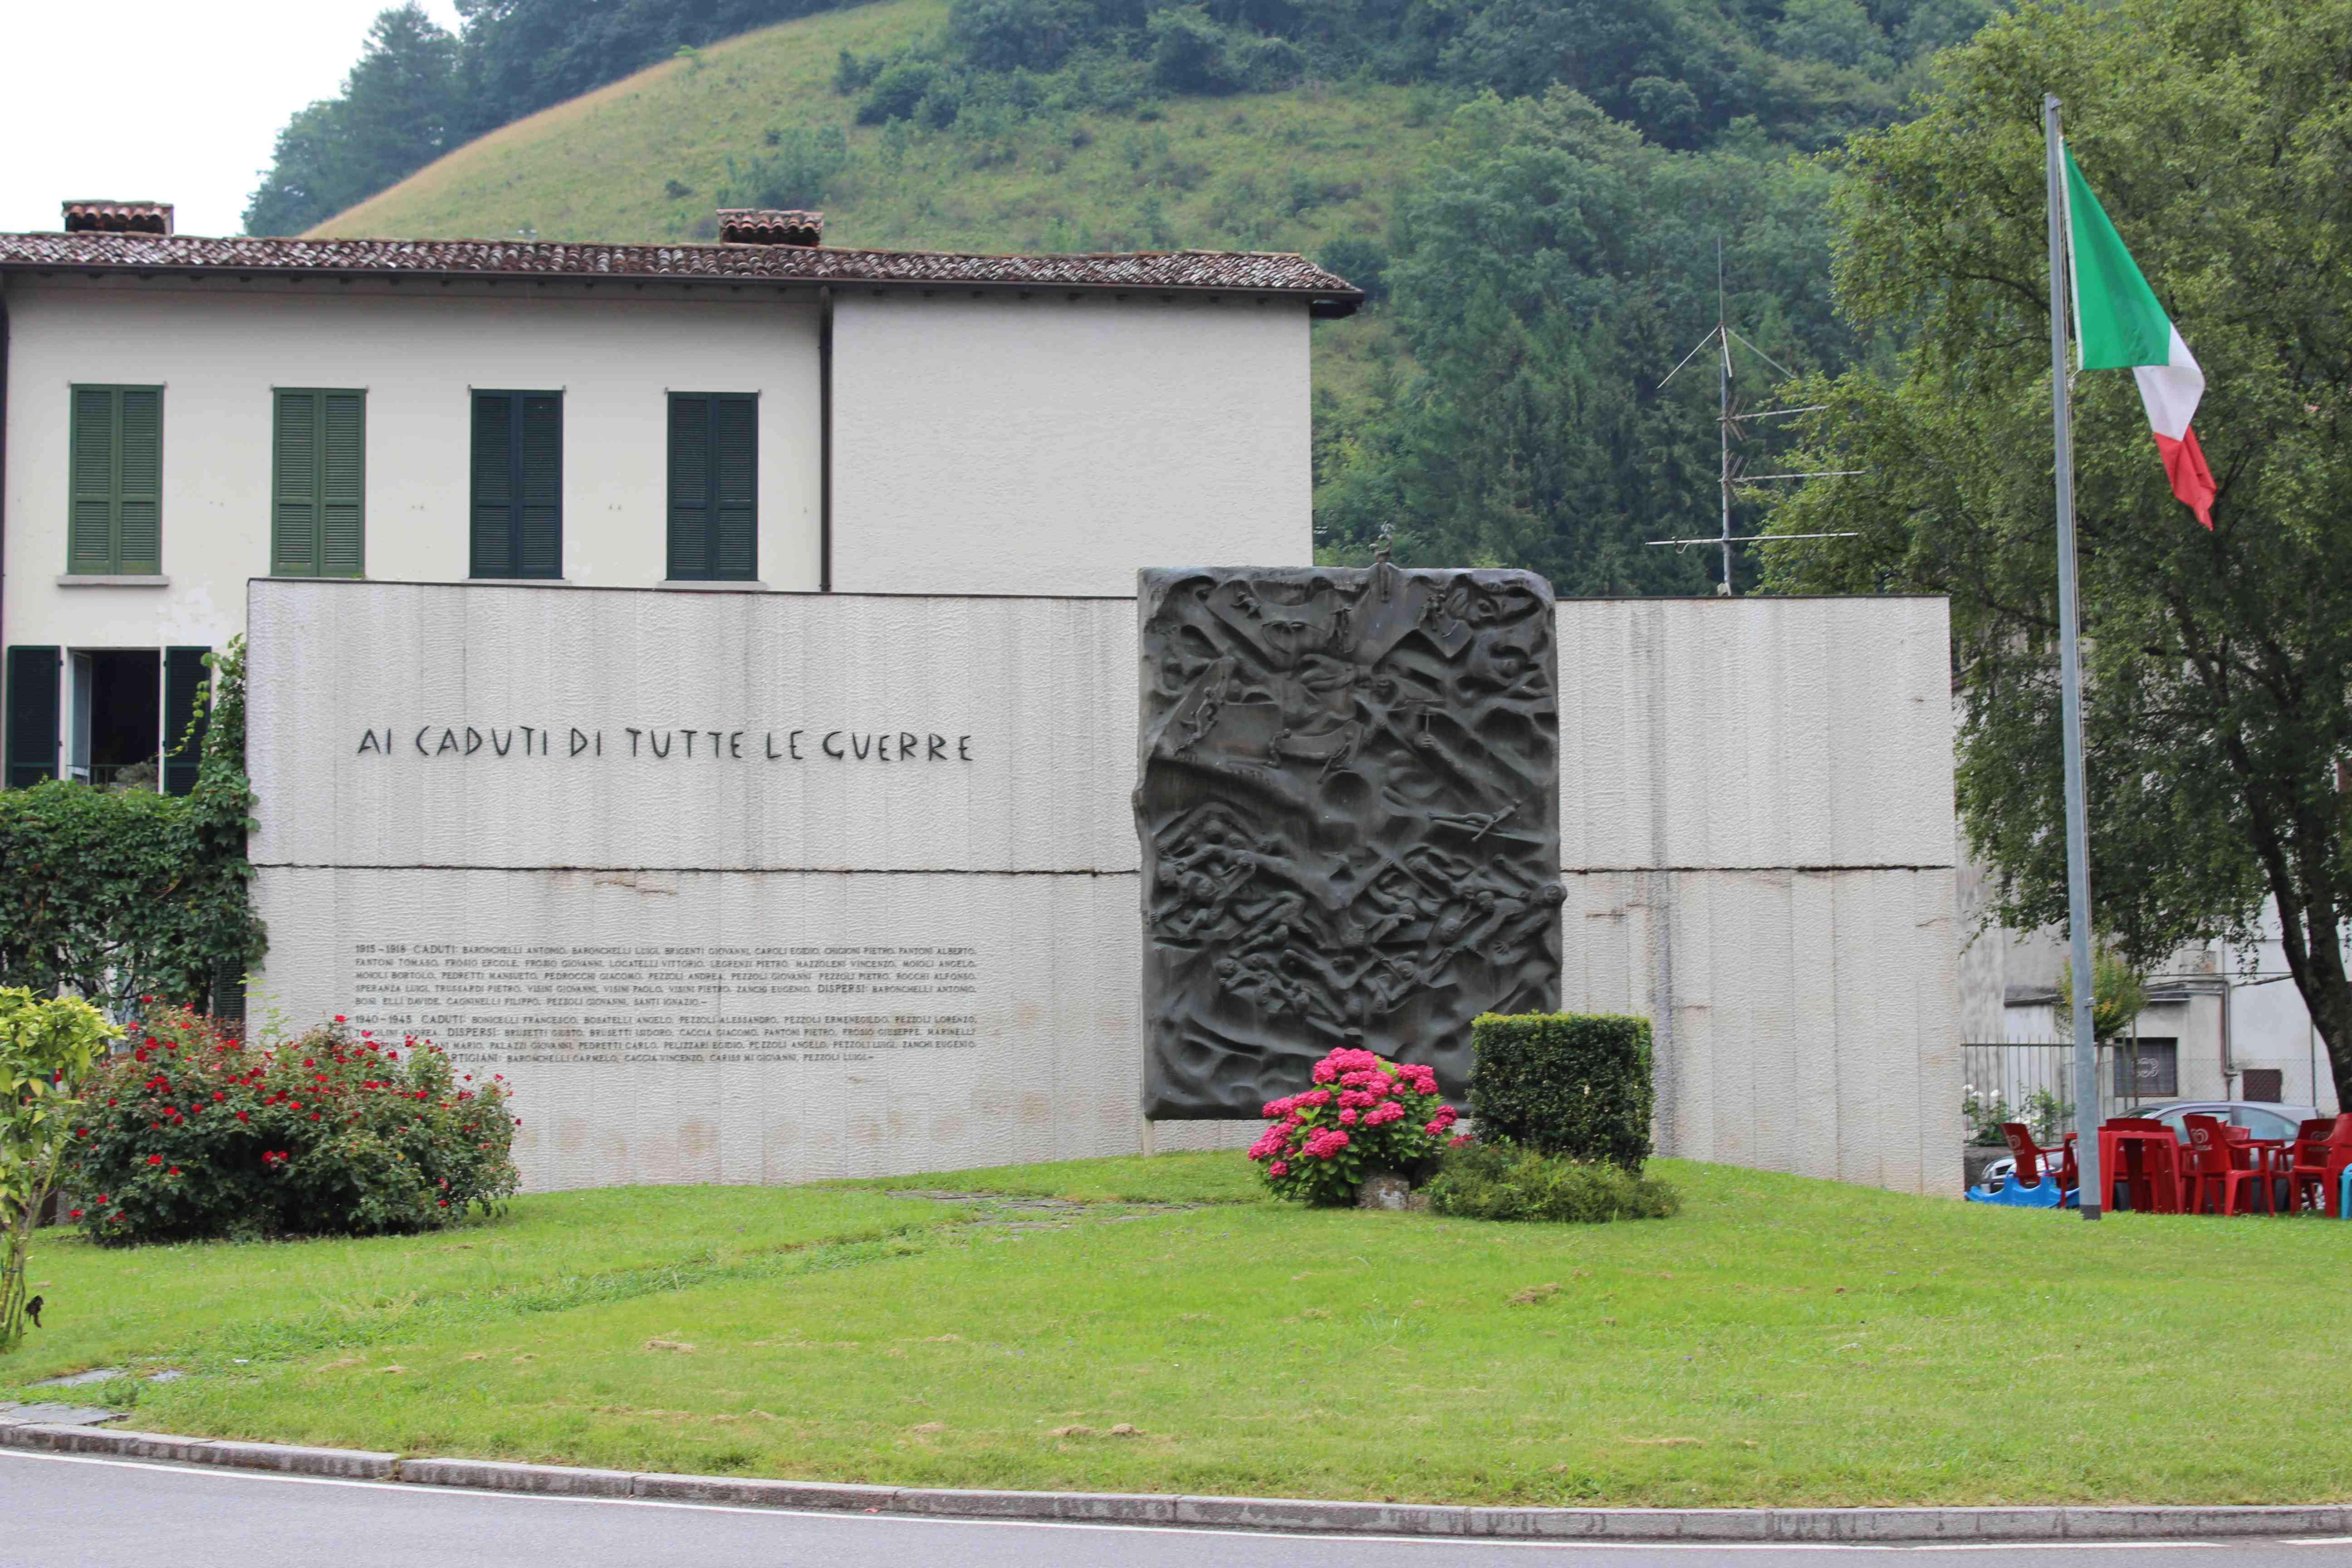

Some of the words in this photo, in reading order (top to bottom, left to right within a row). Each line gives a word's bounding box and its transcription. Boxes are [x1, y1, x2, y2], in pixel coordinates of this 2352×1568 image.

[358, 729, 391, 754] AI
[416, 726, 547, 756] CADUTI
[570, 728, 600, 756] DI
[626, 728, 744, 758] TUTTE
[766, 730, 804, 760] LE
[822, 731, 973, 761] GUERRE
[547, 997, 583, 1005] PEZZOLI
